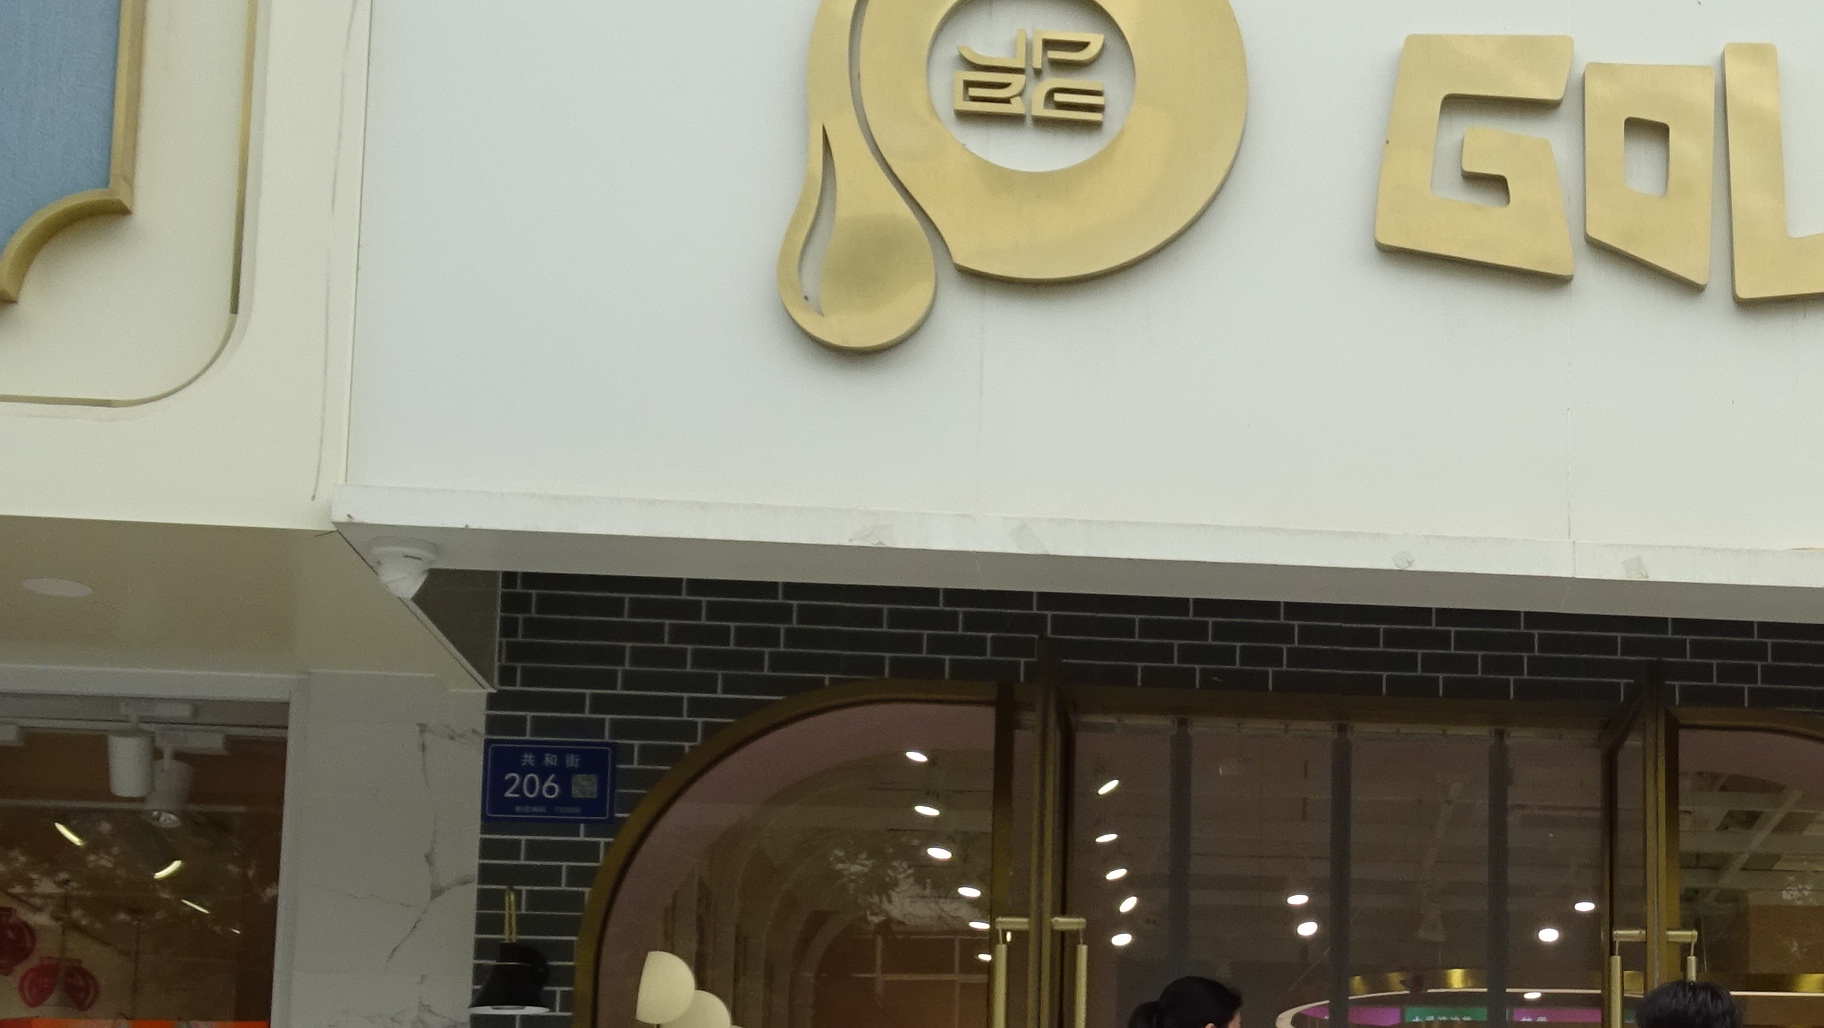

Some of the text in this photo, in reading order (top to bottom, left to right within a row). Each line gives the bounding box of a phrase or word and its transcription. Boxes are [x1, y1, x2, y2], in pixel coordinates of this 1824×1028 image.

[521, 752, 581, 768] 共和街
[504, 772, 560, 799] 206
